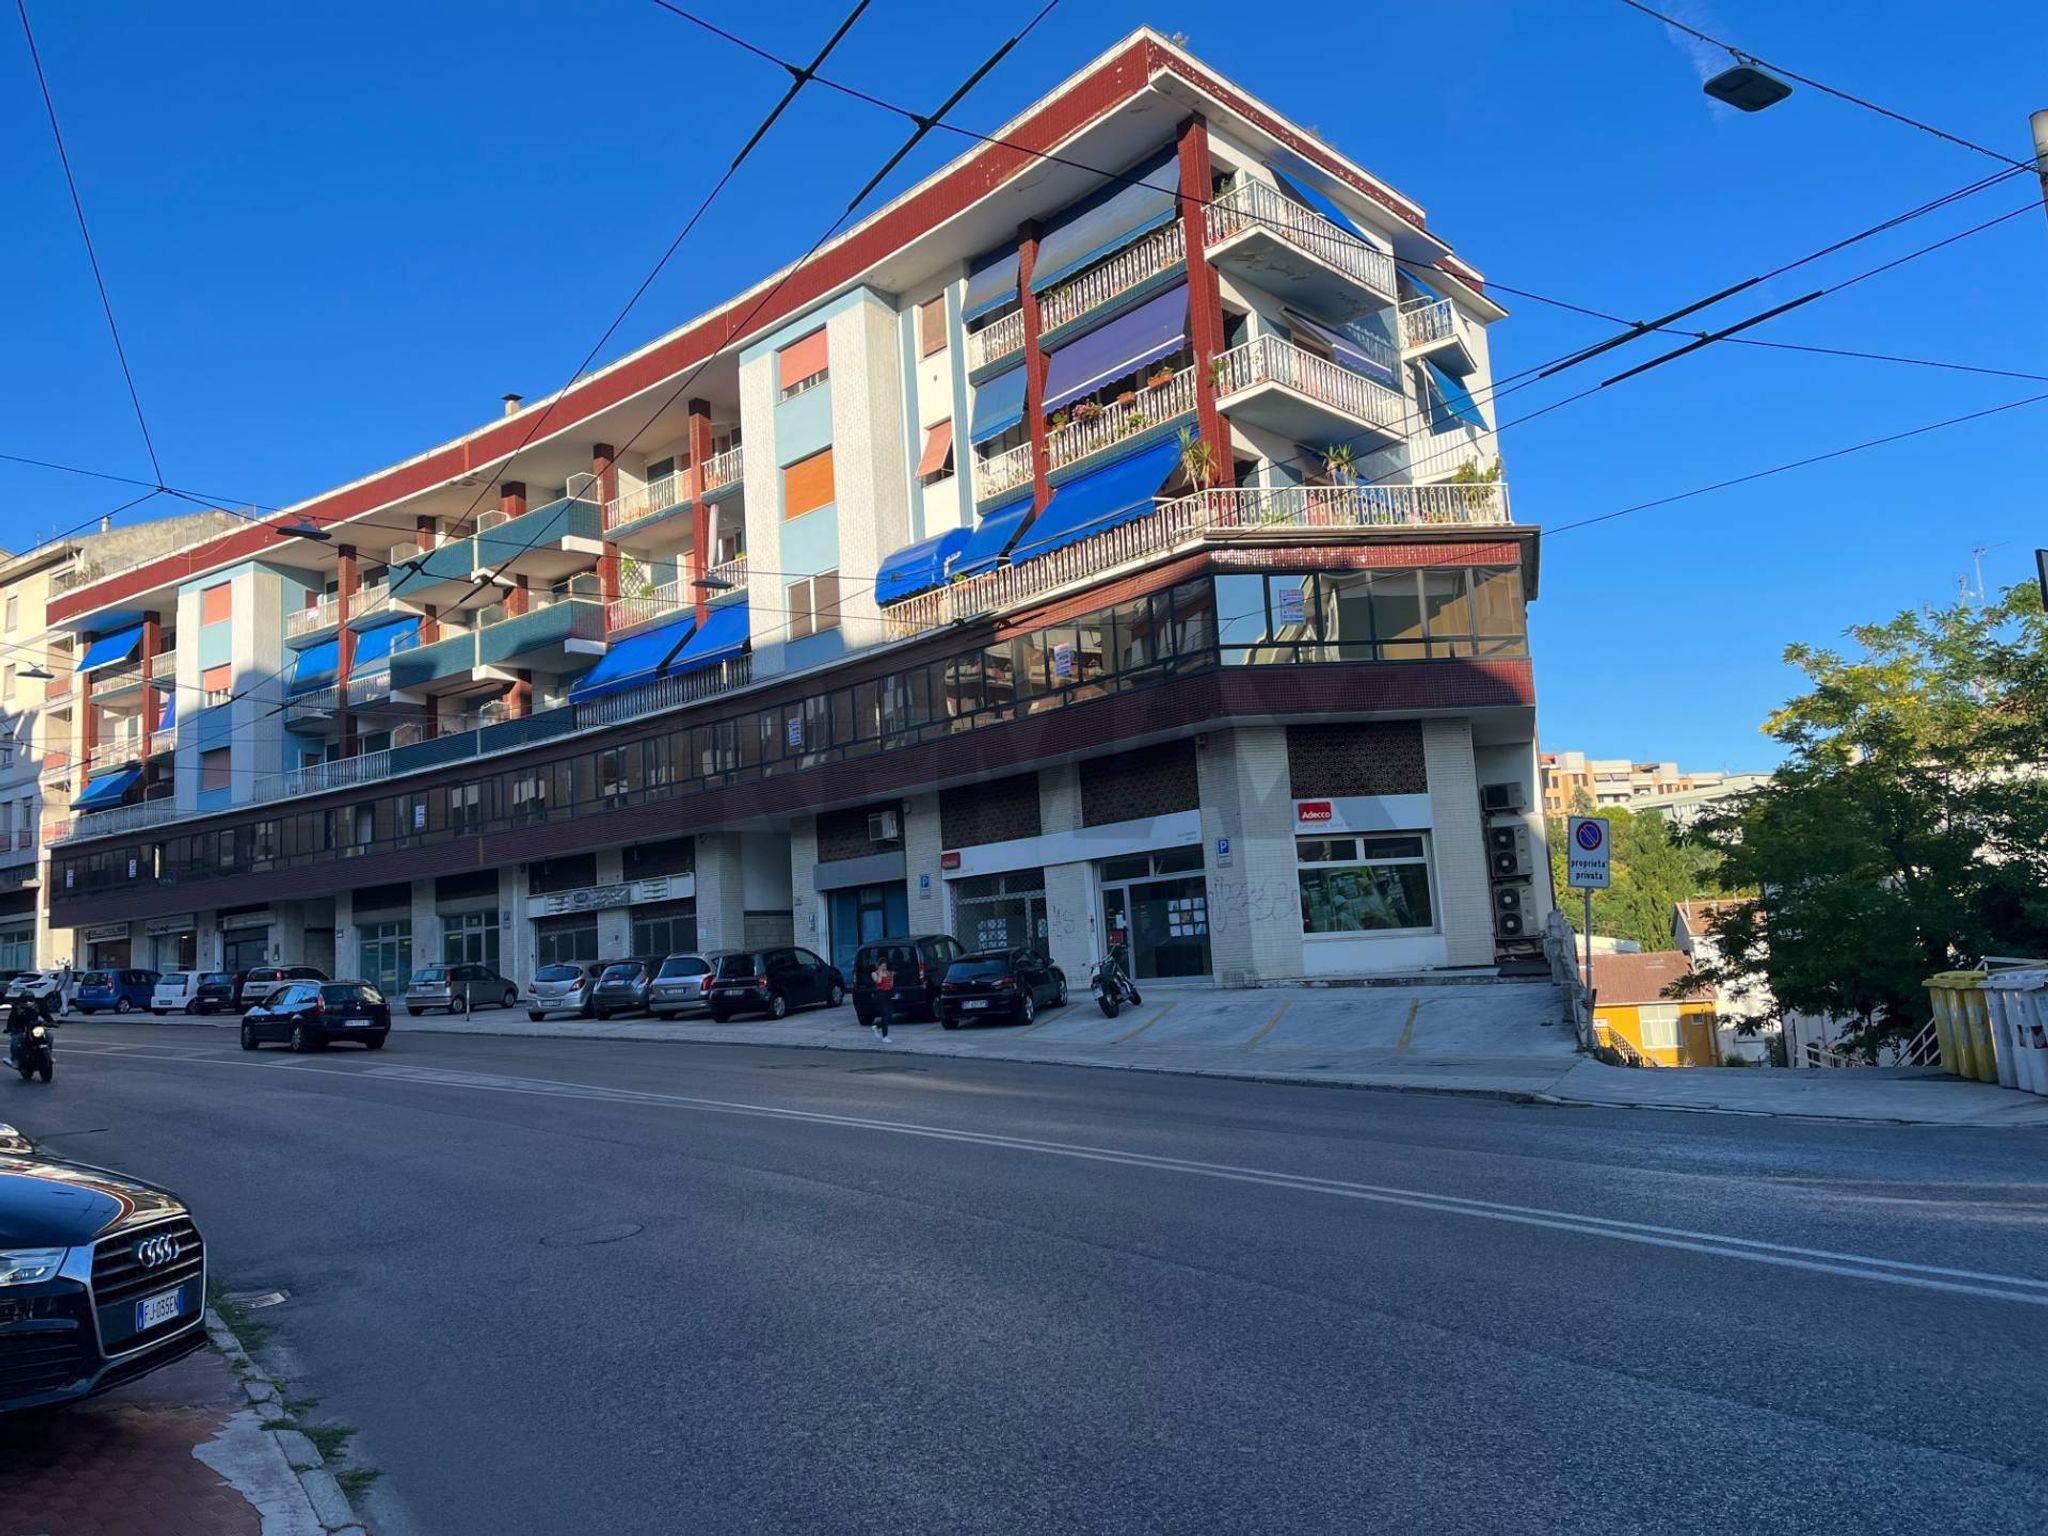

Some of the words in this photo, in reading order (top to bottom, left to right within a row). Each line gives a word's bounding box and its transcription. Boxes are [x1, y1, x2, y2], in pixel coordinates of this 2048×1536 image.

[1302, 811, 1331, 820] Adecco
[1220, 840, 1228, 853] P
[1576, 871, 1603, 880] privata
